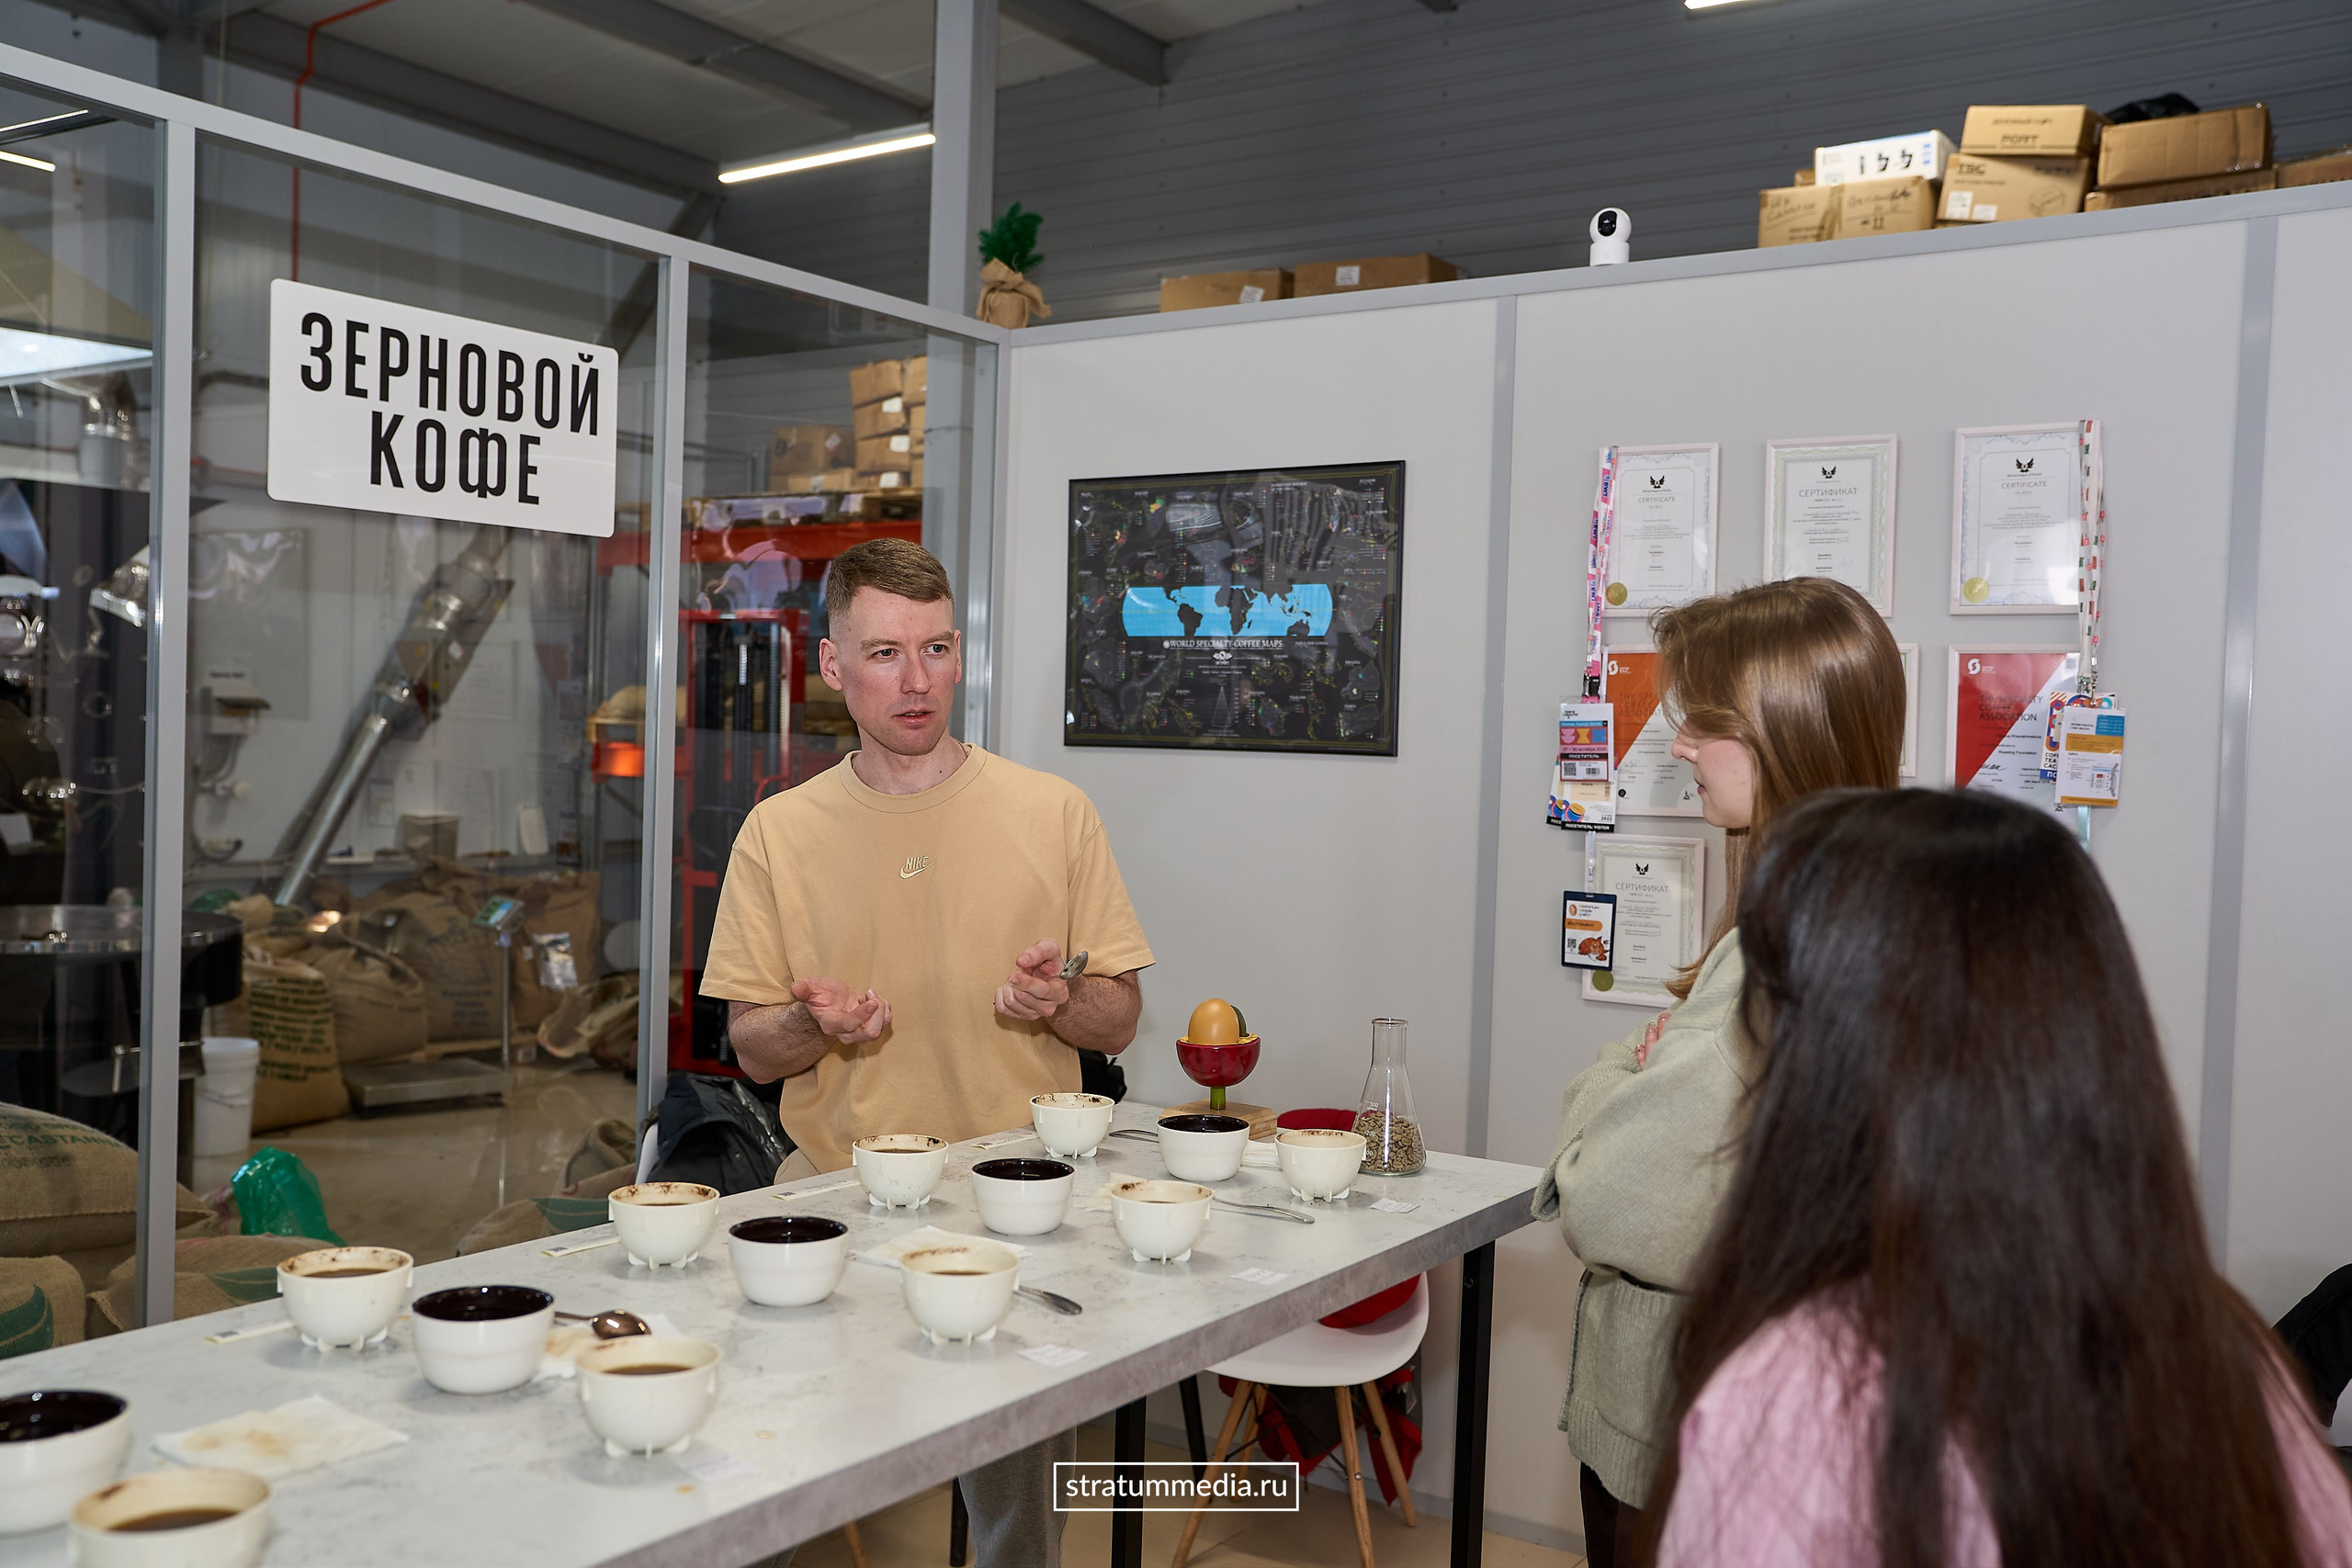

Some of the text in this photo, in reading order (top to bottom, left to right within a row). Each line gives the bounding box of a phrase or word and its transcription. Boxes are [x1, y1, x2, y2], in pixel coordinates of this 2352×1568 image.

[300, 311, 600, 436] ЗЕРНОВОЙ
[370, 411, 541, 505] КОФЕ
[2001, 480, 2047, 490] CERTIFICATE
[1799, 487, 1858, 498] СЕРТИФИКАТ
[1170, 639, 1195, 649] WORLD
[1261, 639, 1283, 648] MAPS
[1979, 713, 2038, 722] ASSOCIATION
[906, 856, 928, 870] NIKE
[1615, 882, 1668, 894] СЕРТИФИКАТ
